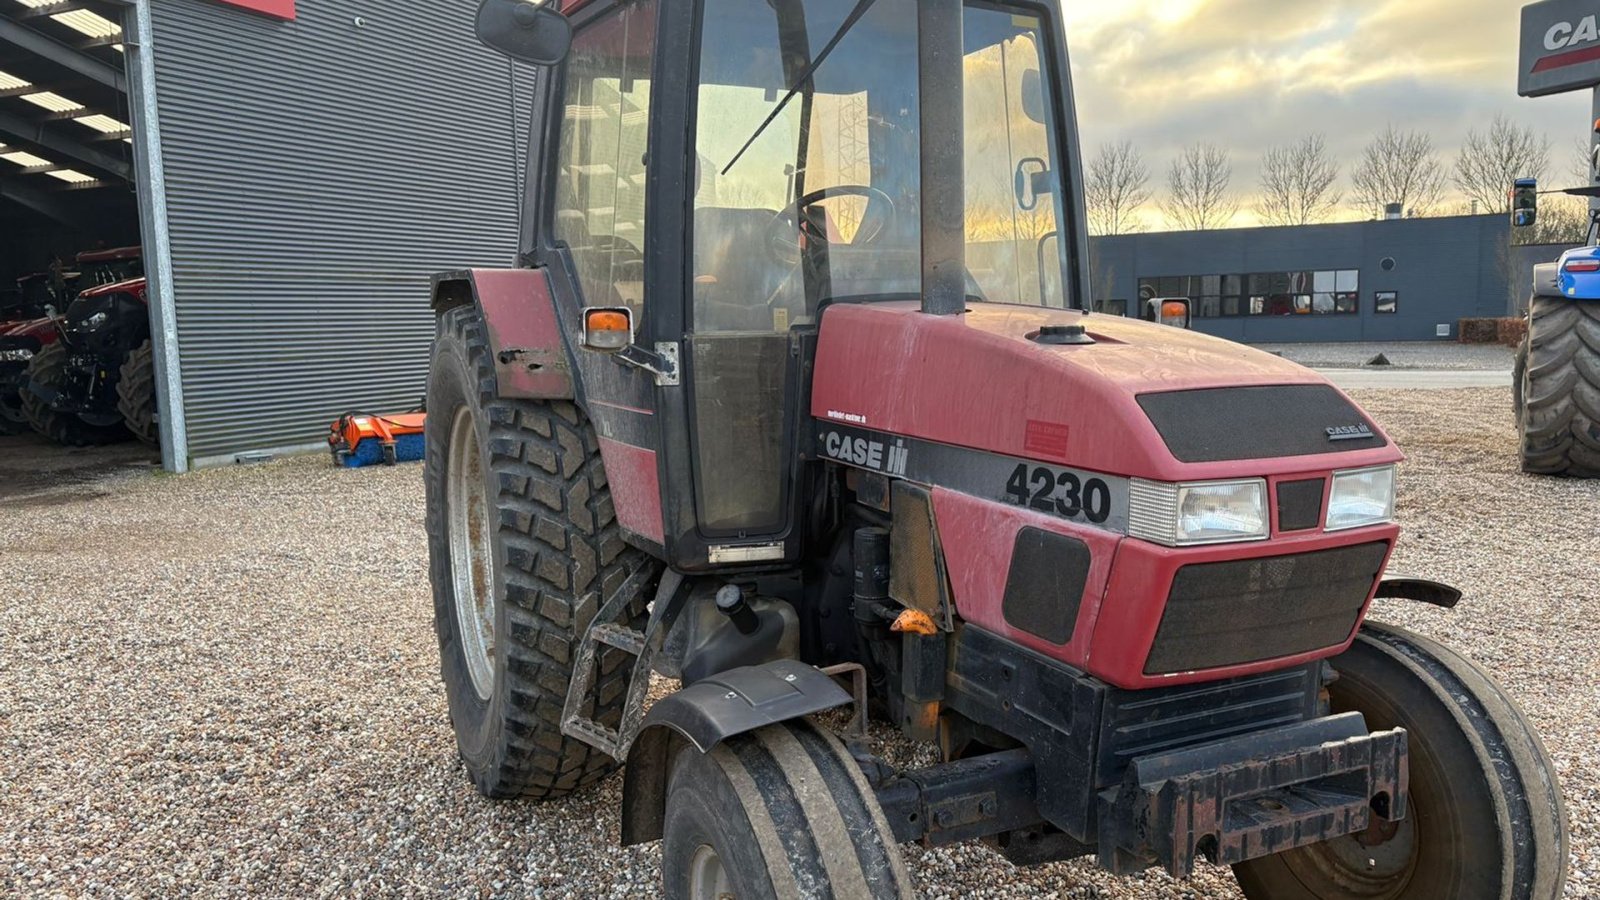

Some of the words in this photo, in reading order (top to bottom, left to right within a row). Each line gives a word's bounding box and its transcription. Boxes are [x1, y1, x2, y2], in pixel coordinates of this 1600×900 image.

[1544, 14, 1600, 51] CA
[1325, 425, 1358, 435] CASE
[826, 431, 883, 470] CASE
[1006, 463, 1111, 523] 4230
